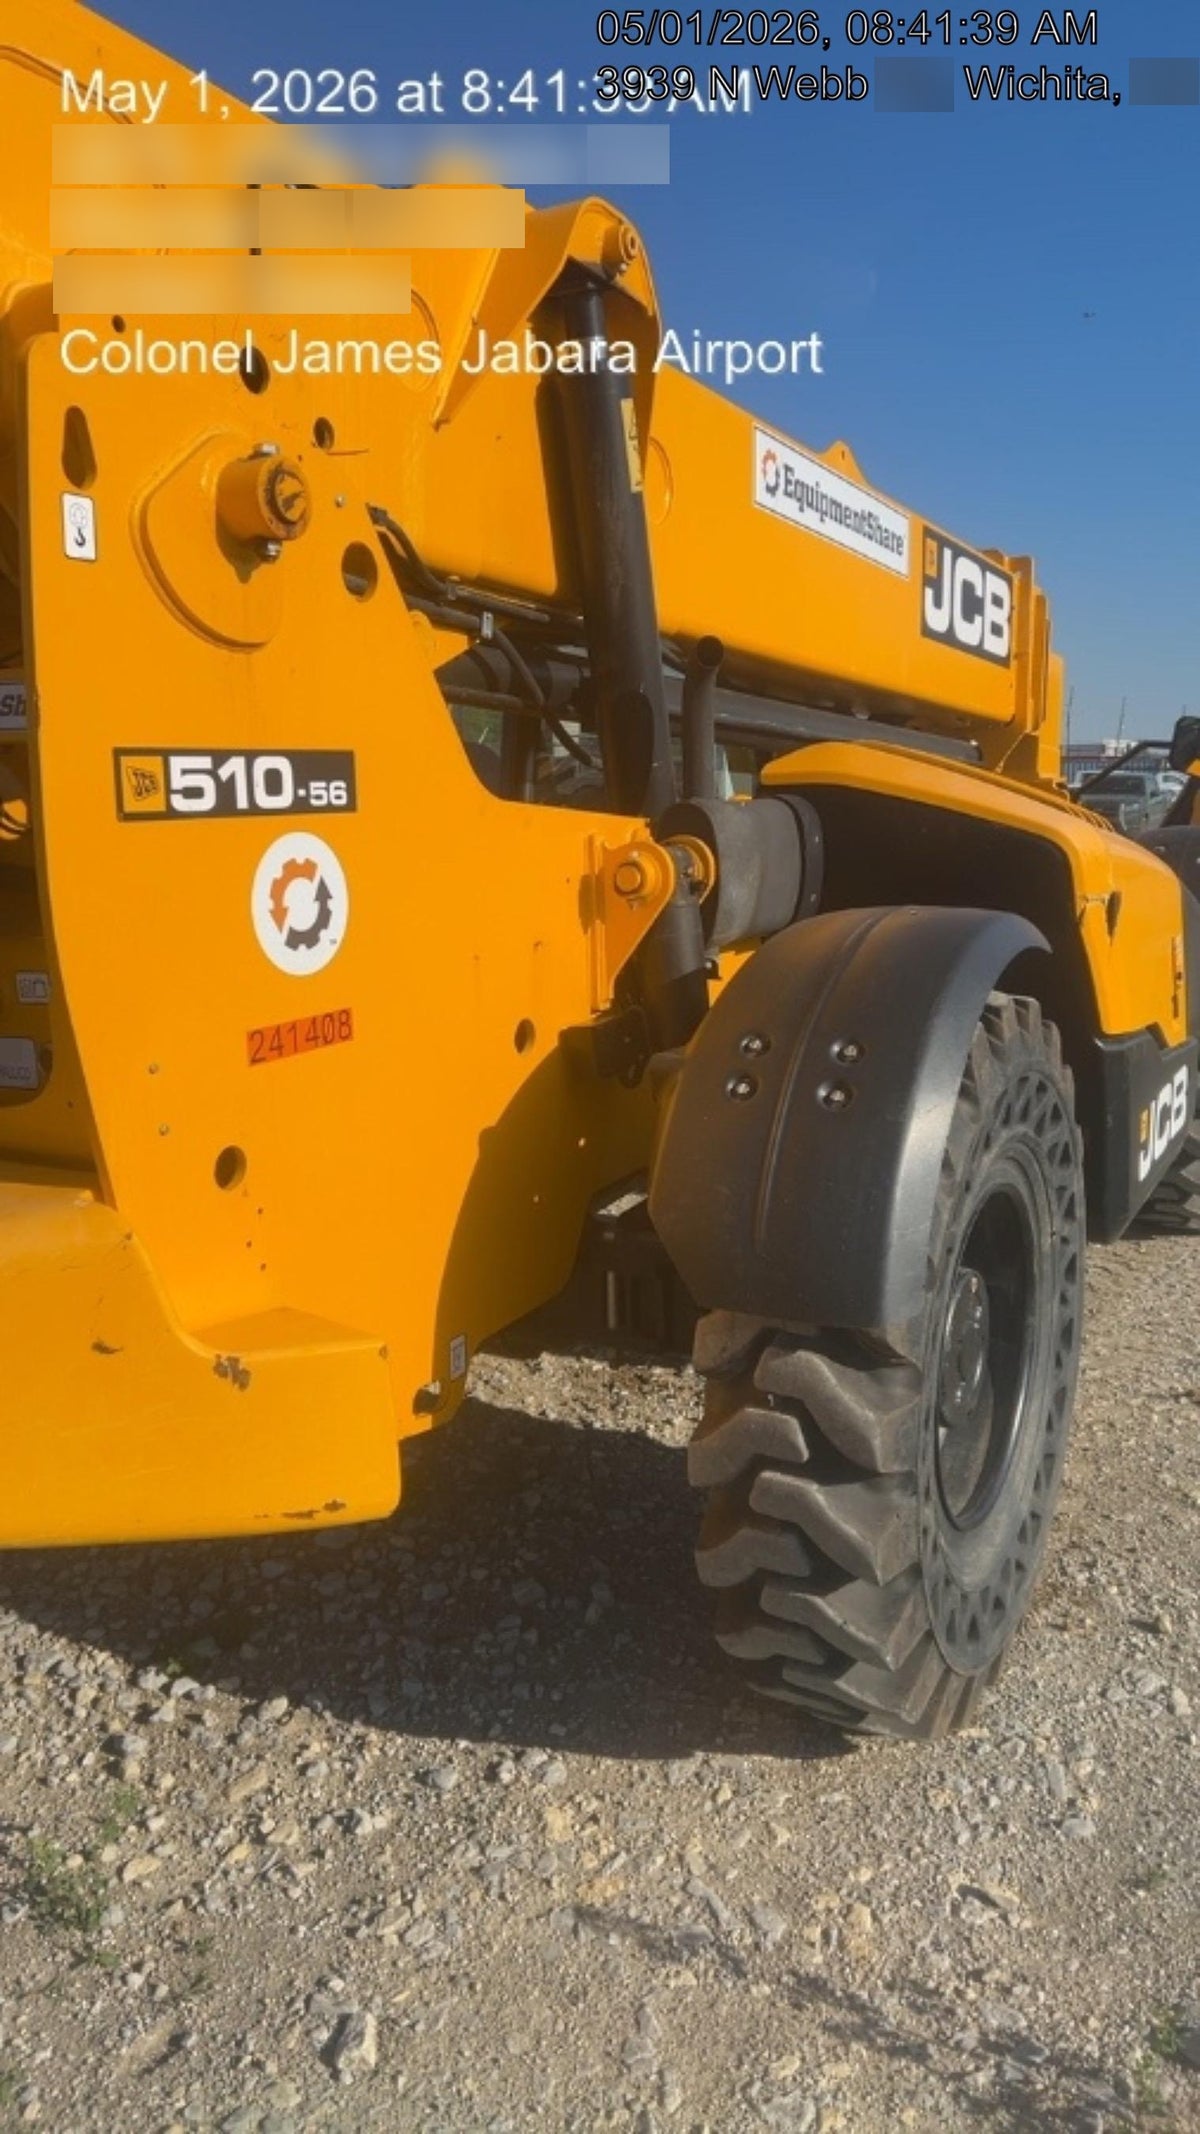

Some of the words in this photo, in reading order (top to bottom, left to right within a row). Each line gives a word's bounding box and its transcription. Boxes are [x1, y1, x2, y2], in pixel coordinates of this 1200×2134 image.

[781, 462, 905, 557] EquipmentShare
[924, 546, 1011, 658] JCB
[249, 1008, 352, 1065] 241408
[1138, 1063, 1189, 1182] JCB
